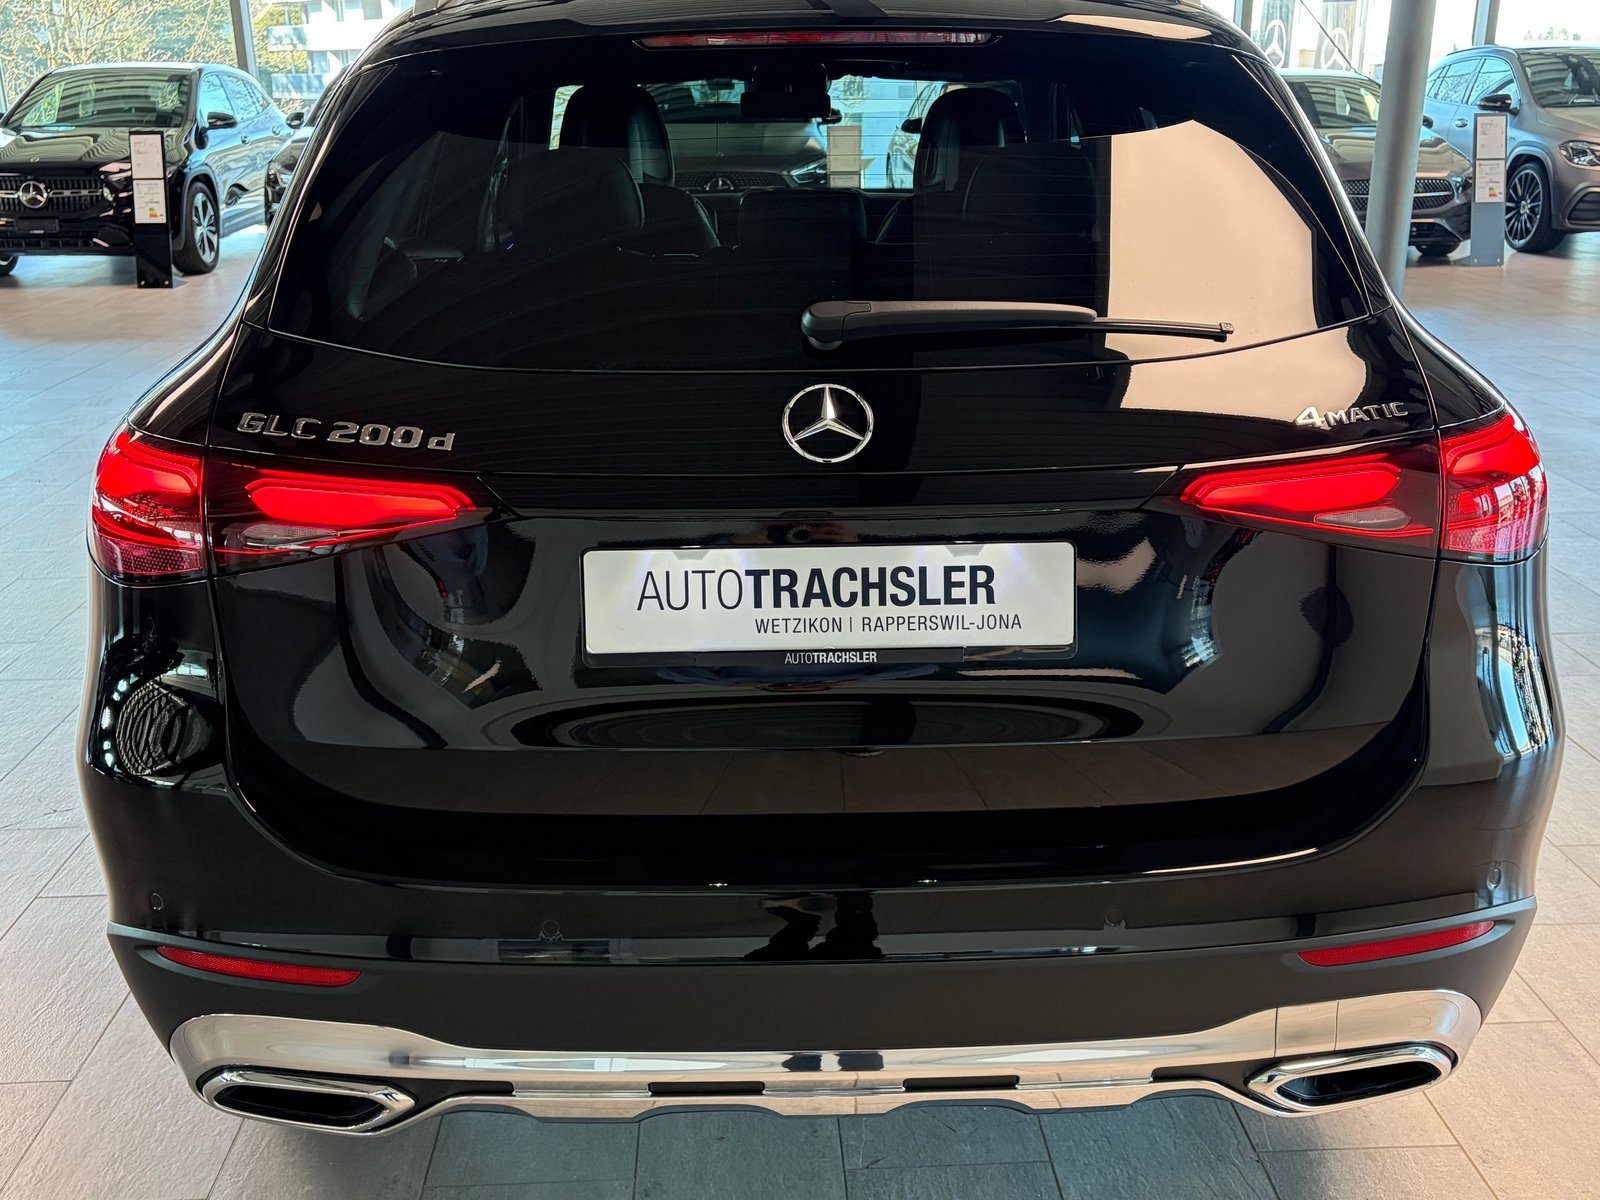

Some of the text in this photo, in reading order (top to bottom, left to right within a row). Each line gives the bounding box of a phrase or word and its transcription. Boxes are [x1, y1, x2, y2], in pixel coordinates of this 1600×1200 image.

[1295, 401, 1409, 428] 4MATIC
[236, 411, 456, 451] GLC 200 d
[636, 564, 997, 612] AUTOTRACHSLER
[755, 616, 843, 634] WETZIKON
[861, 613, 1022, 632] RAPPERSWIL-JONA
[784, 651, 878, 665] AUTOTRACHSLER
